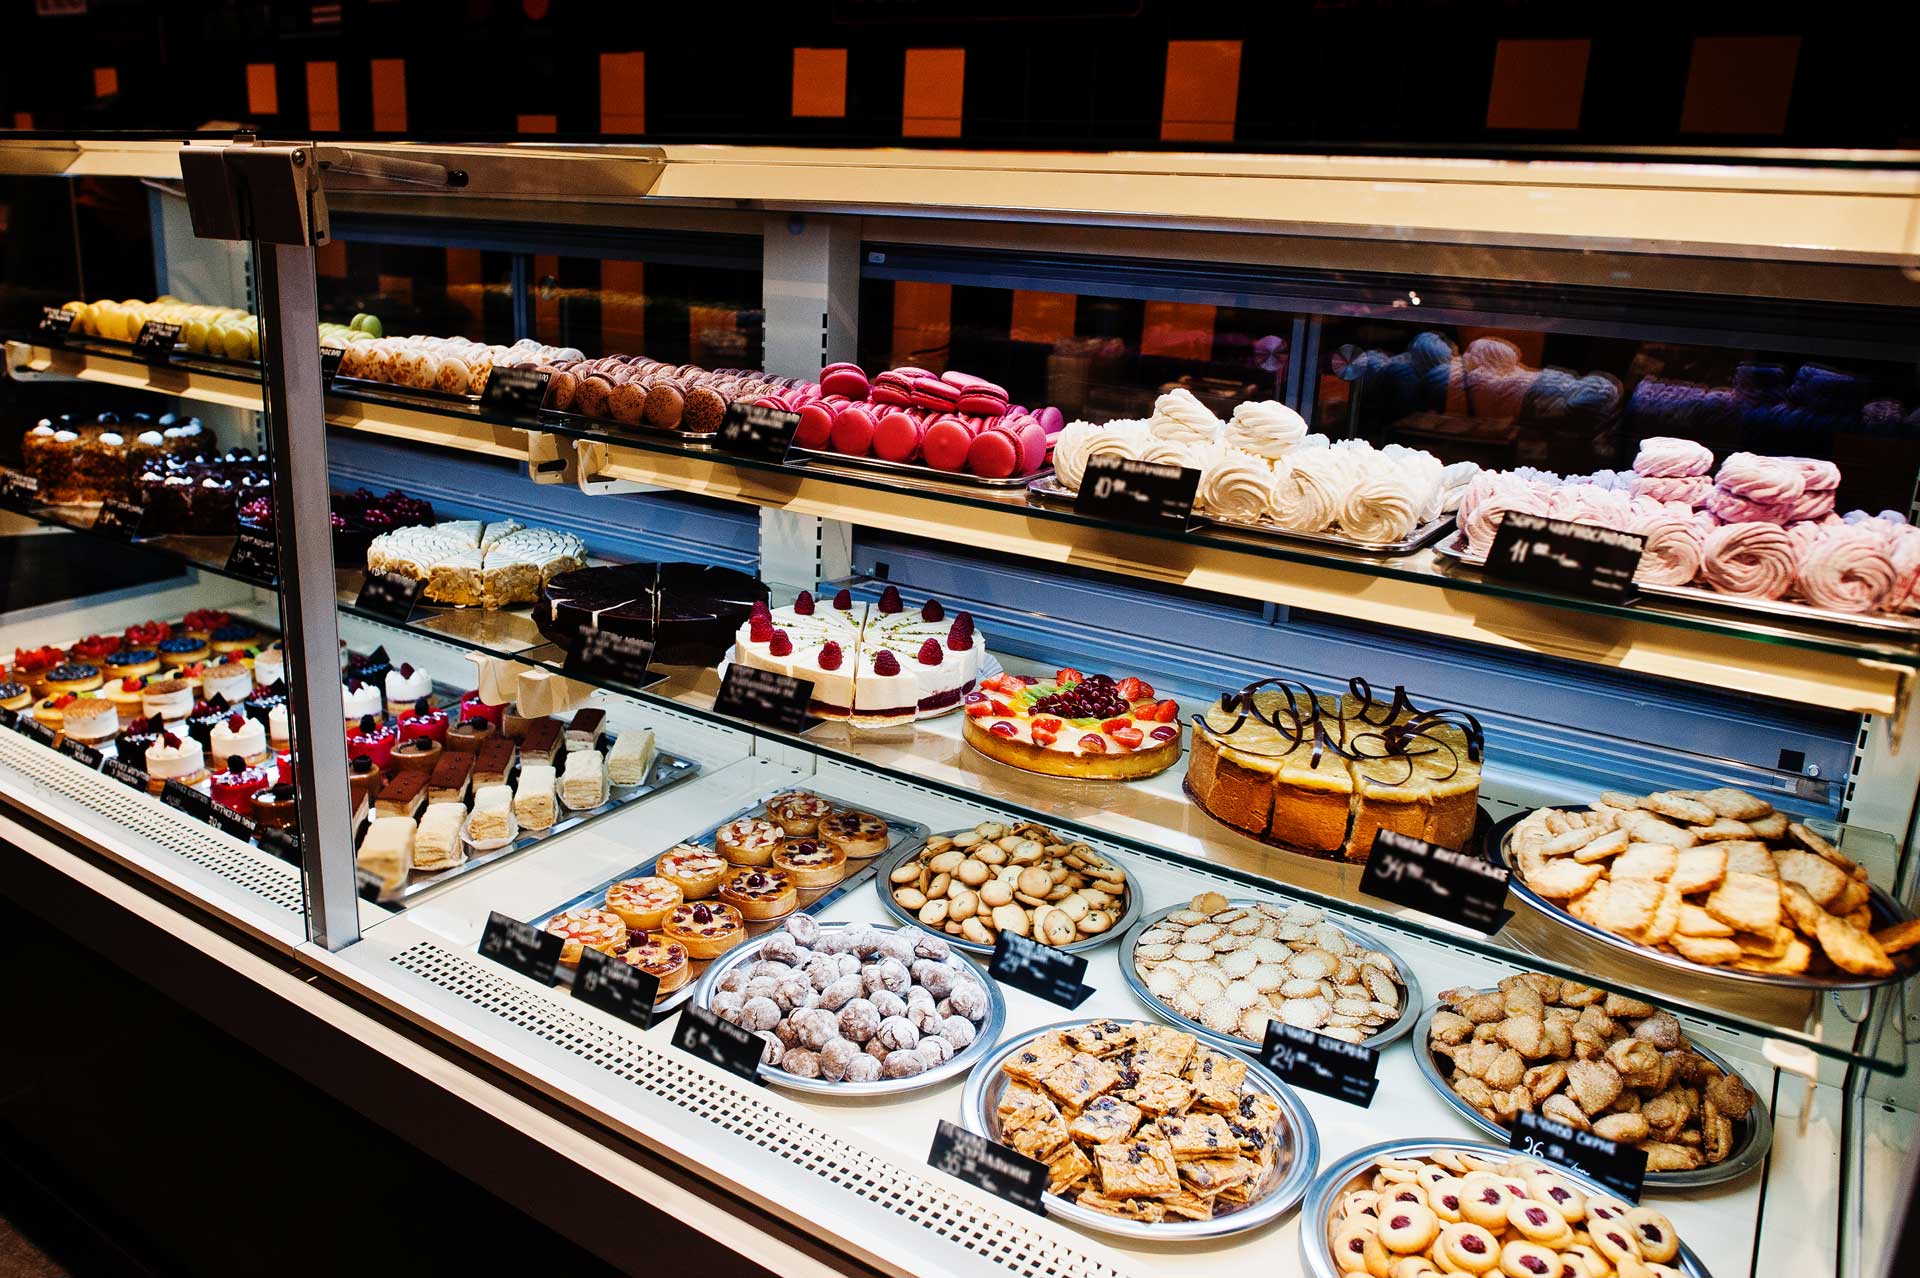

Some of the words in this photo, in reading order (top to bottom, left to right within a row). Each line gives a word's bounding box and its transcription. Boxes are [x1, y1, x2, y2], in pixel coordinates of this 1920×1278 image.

[1509, 539, 1530, 563] 11
[1269, 1043, 1296, 1070] 24
[1522, 1136, 1545, 1158] 26
